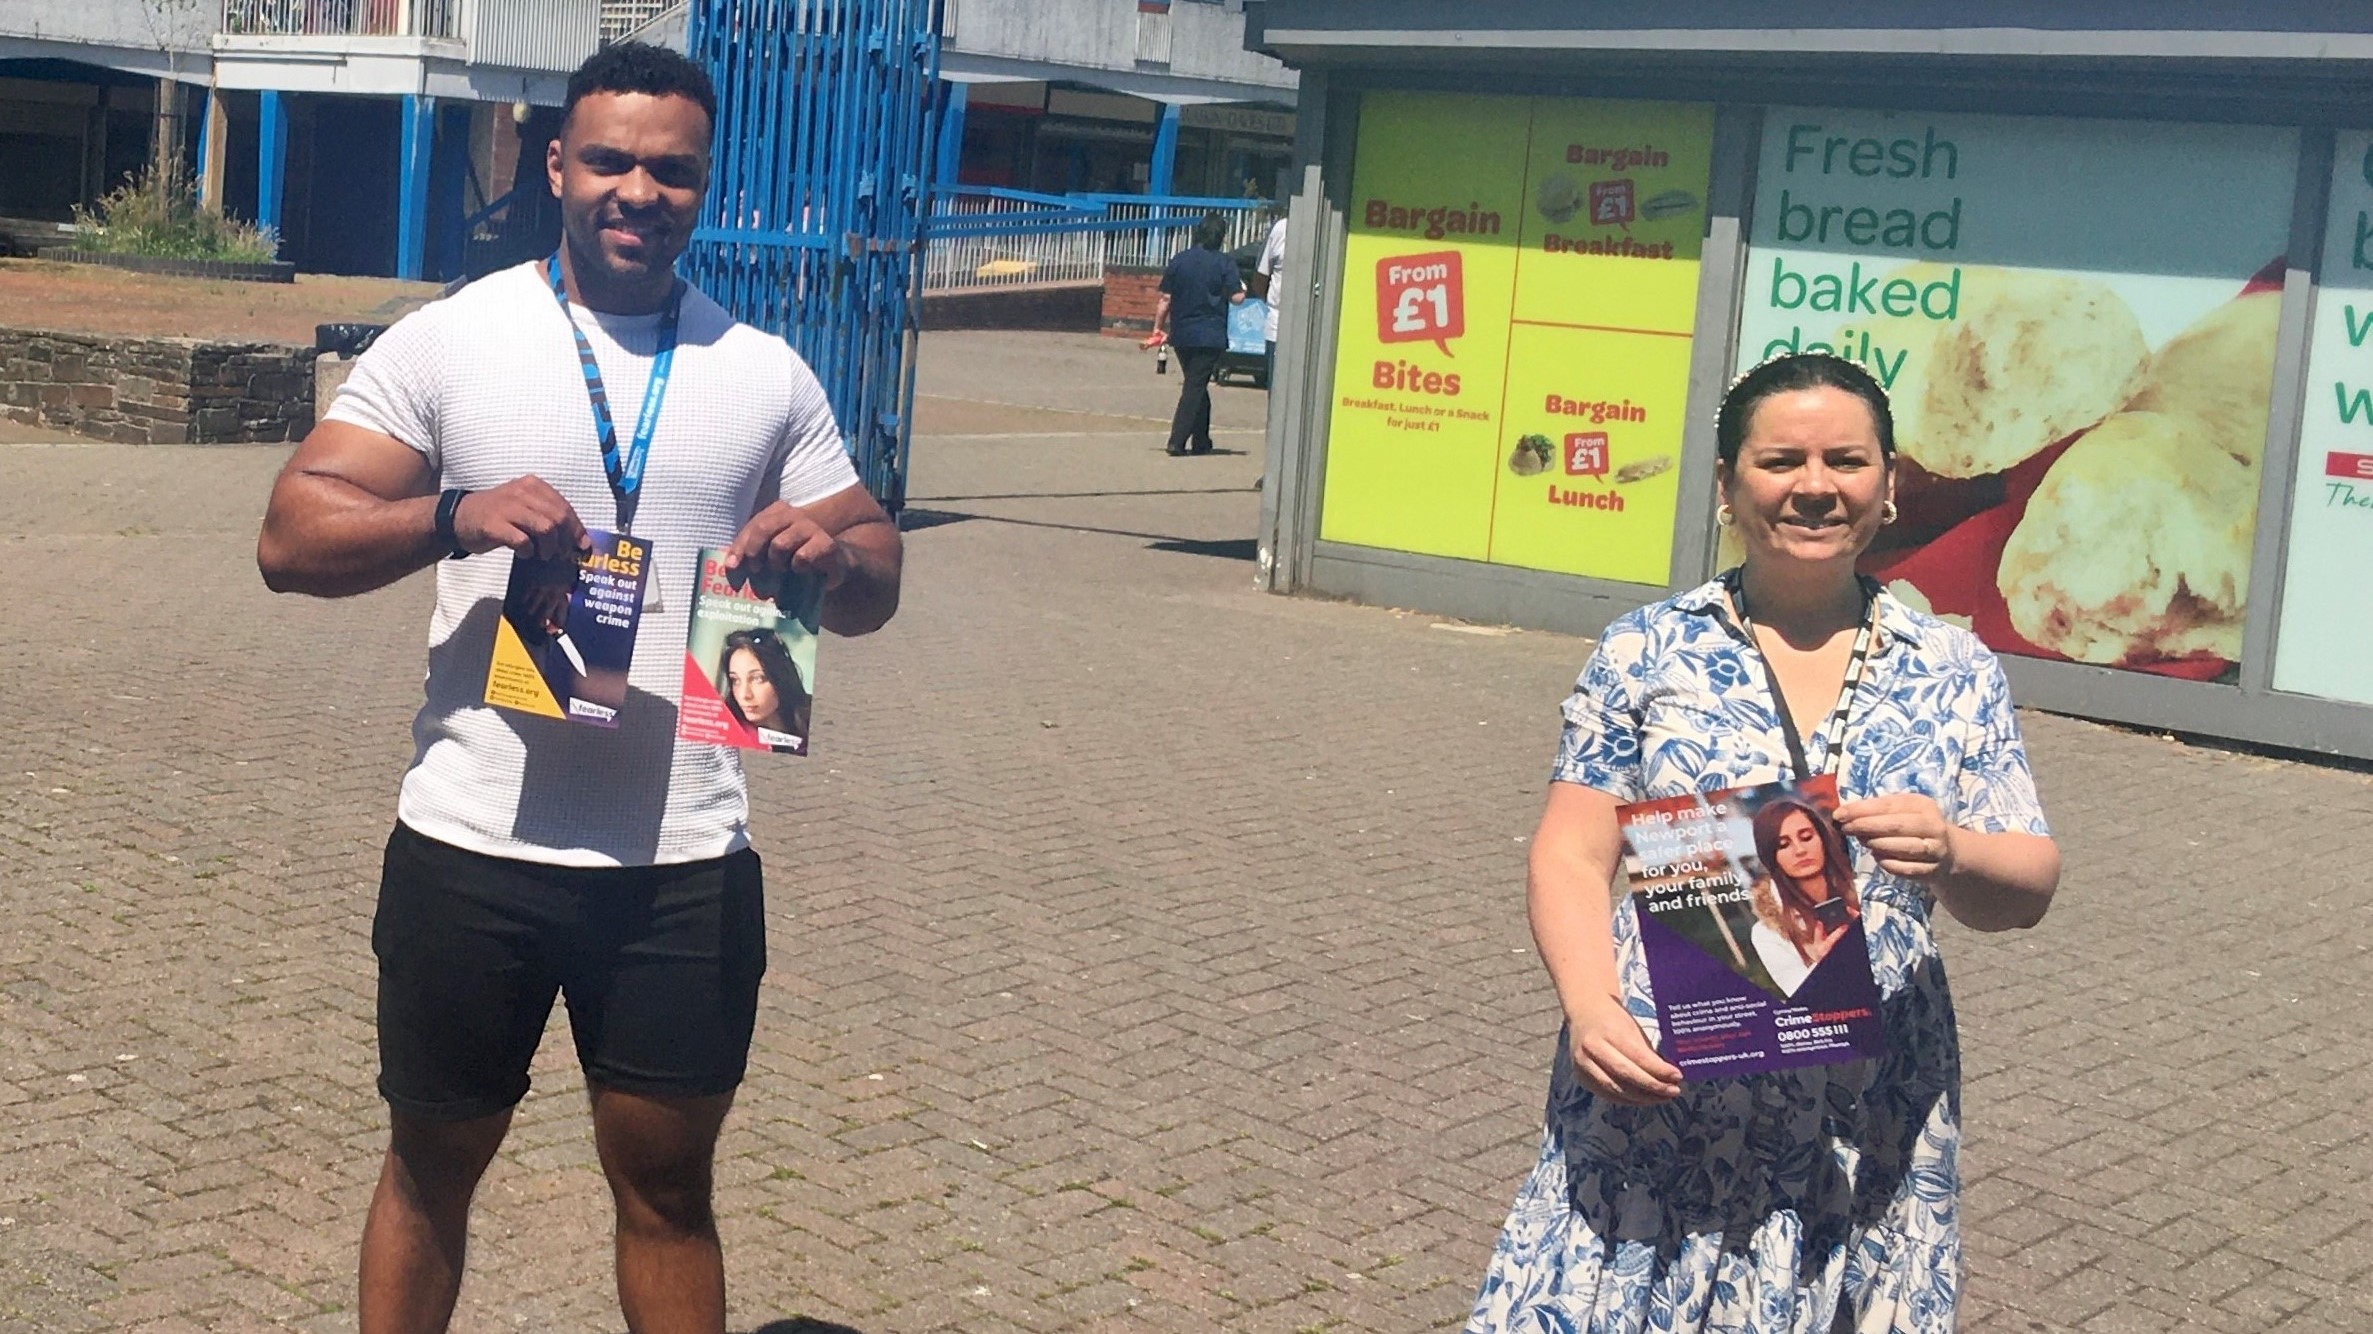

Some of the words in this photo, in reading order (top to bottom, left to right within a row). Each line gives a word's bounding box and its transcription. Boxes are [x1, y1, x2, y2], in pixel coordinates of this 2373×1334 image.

[1566, 144, 1670, 172] Bargain
[1785, 123, 1959, 181] Fresh
[1595, 182, 1627, 197] From
[1597, 193, 1629, 221] £1
[1364, 198, 1500, 241] Bargain
[1777, 189, 1962, 250] bread
[1543, 232, 1674, 260] Breakfast
[1389, 260, 1448, 286] From
[1769, 256, 1962, 321] baked
[1392, 283, 1449, 333] £1
[1372, 359, 1461, 397] Bites
[1399, 402, 1432, 416] Lunch
[1433, 407, 1446, 417] or
[1448, 410, 1455, 418] a
[1456, 408, 1490, 421] Snack
[1545, 394, 1647, 424] Bargain
[1387, 416, 1403, 428] for
[1404, 417, 1426, 431] just
[1427, 421, 1440, 432] £1
[1574, 435, 1605, 448] From
[1571, 446, 1600, 471] £1
[1548, 484, 1625, 513] Lunch
[617, 539, 643, 561] Be
[578, 569, 616, 587] Speak
[617, 578, 638, 591] out
[589, 586, 635, 604] against
[698, 594, 732, 609] Speak
[733, 600, 752, 613] out
[584, 598, 633, 616] weapon
[697, 609, 760, 627] exploitation
[595, 613, 630, 629] crime
[578, 703, 614, 718] fearless
[1631, 810, 1673, 827] Help
[1677, 803, 1727, 820] make
[1635, 821, 1713, 844] Newport
[1716, 821, 1727, 832] a
[1638, 845, 1681, 861] safer
[1686, 838, 1733, 857] place
[1641, 864, 1666, 879] for
[1669, 860, 1709, 878] you,
[1644, 880, 1684, 899] your
[1689, 871, 1742, 890] family
[1648, 895, 1683, 913] and
[1711, 999, 1726, 1007] you
[1777, 1028, 1811, 1042] 0800
[1679, 1050, 1766, 1067] crimestoppers-uk.org
